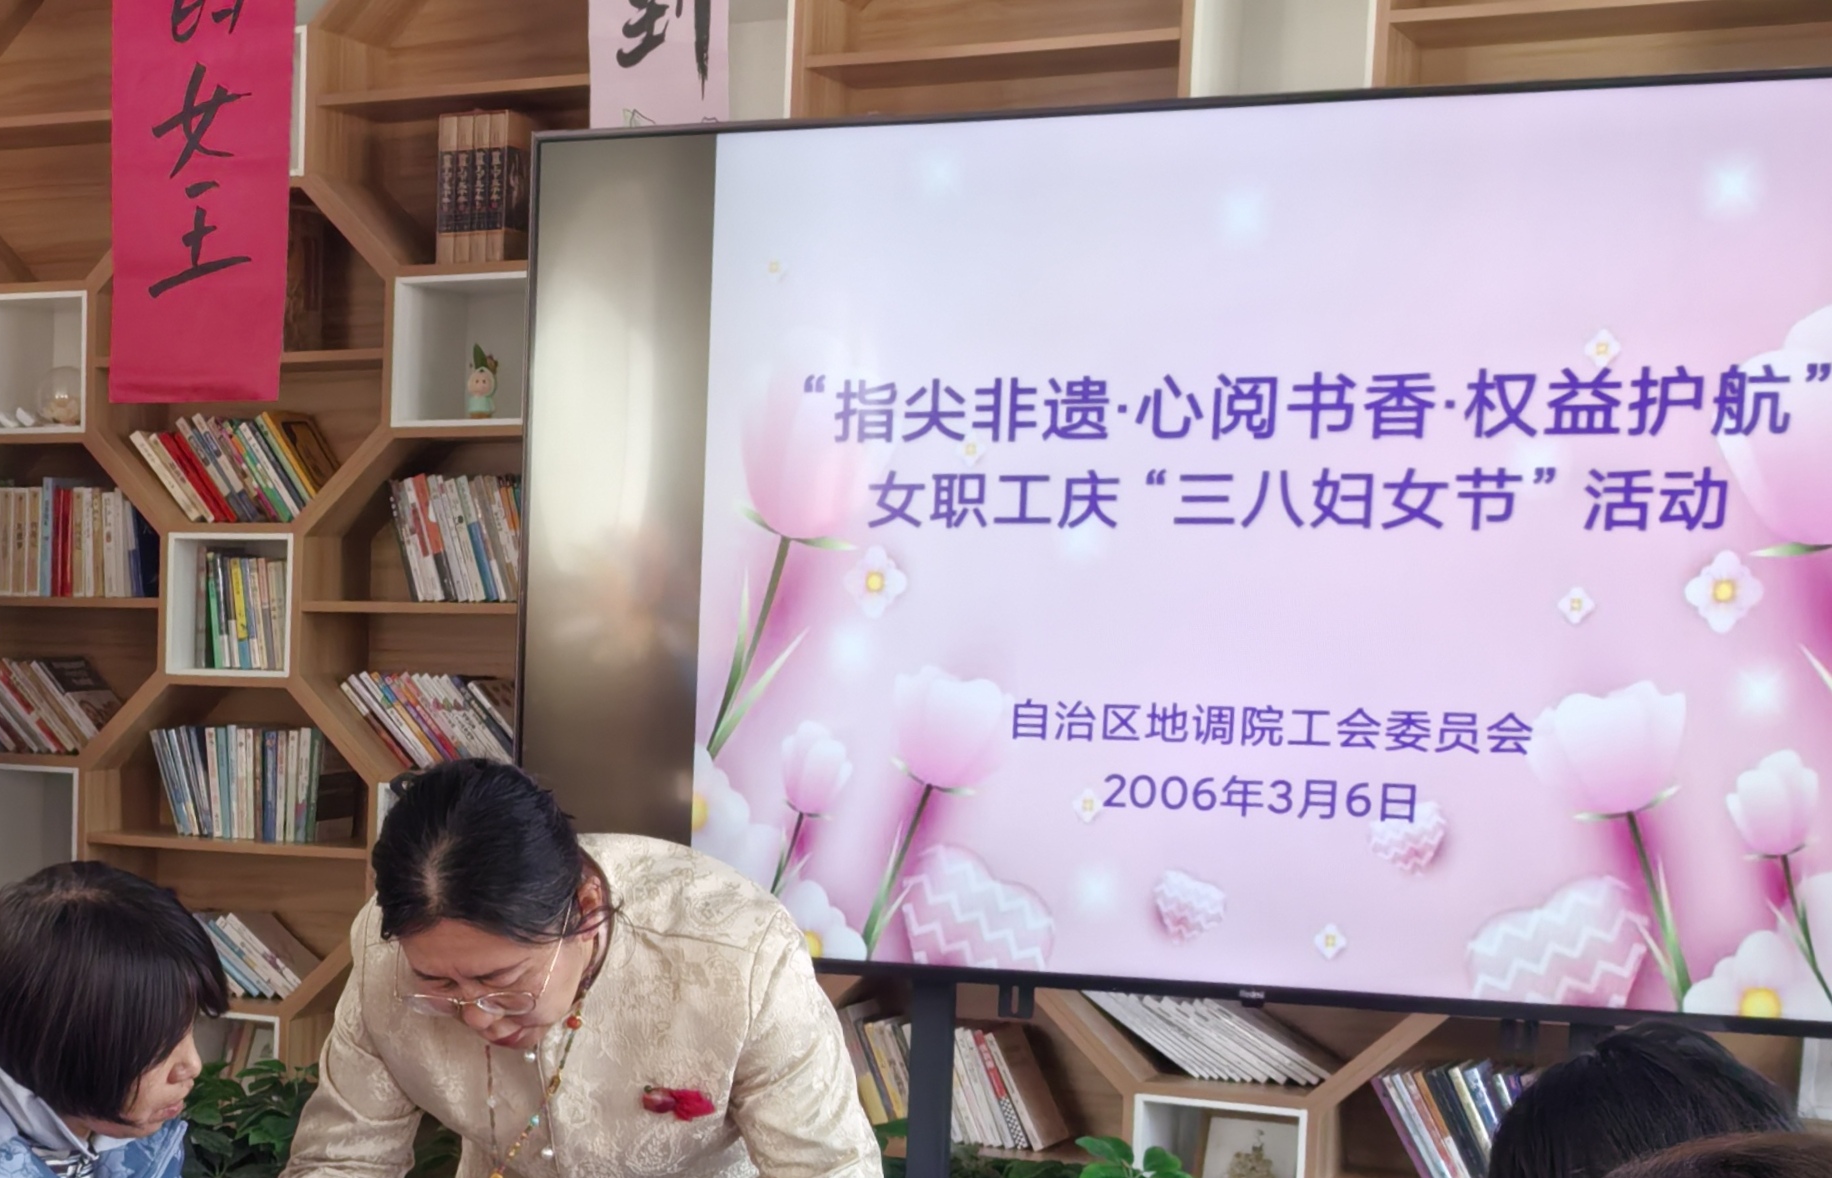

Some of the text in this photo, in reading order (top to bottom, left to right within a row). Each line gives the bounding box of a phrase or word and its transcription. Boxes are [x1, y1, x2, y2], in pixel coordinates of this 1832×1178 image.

[804, 363, 1832, 443] “指尖非遗·心阅书香·权益护航”
[1011, 699, 1534, 756] 自治区地调院工会委员会
[1101, 773, 1418, 824] 2006年3月6日
